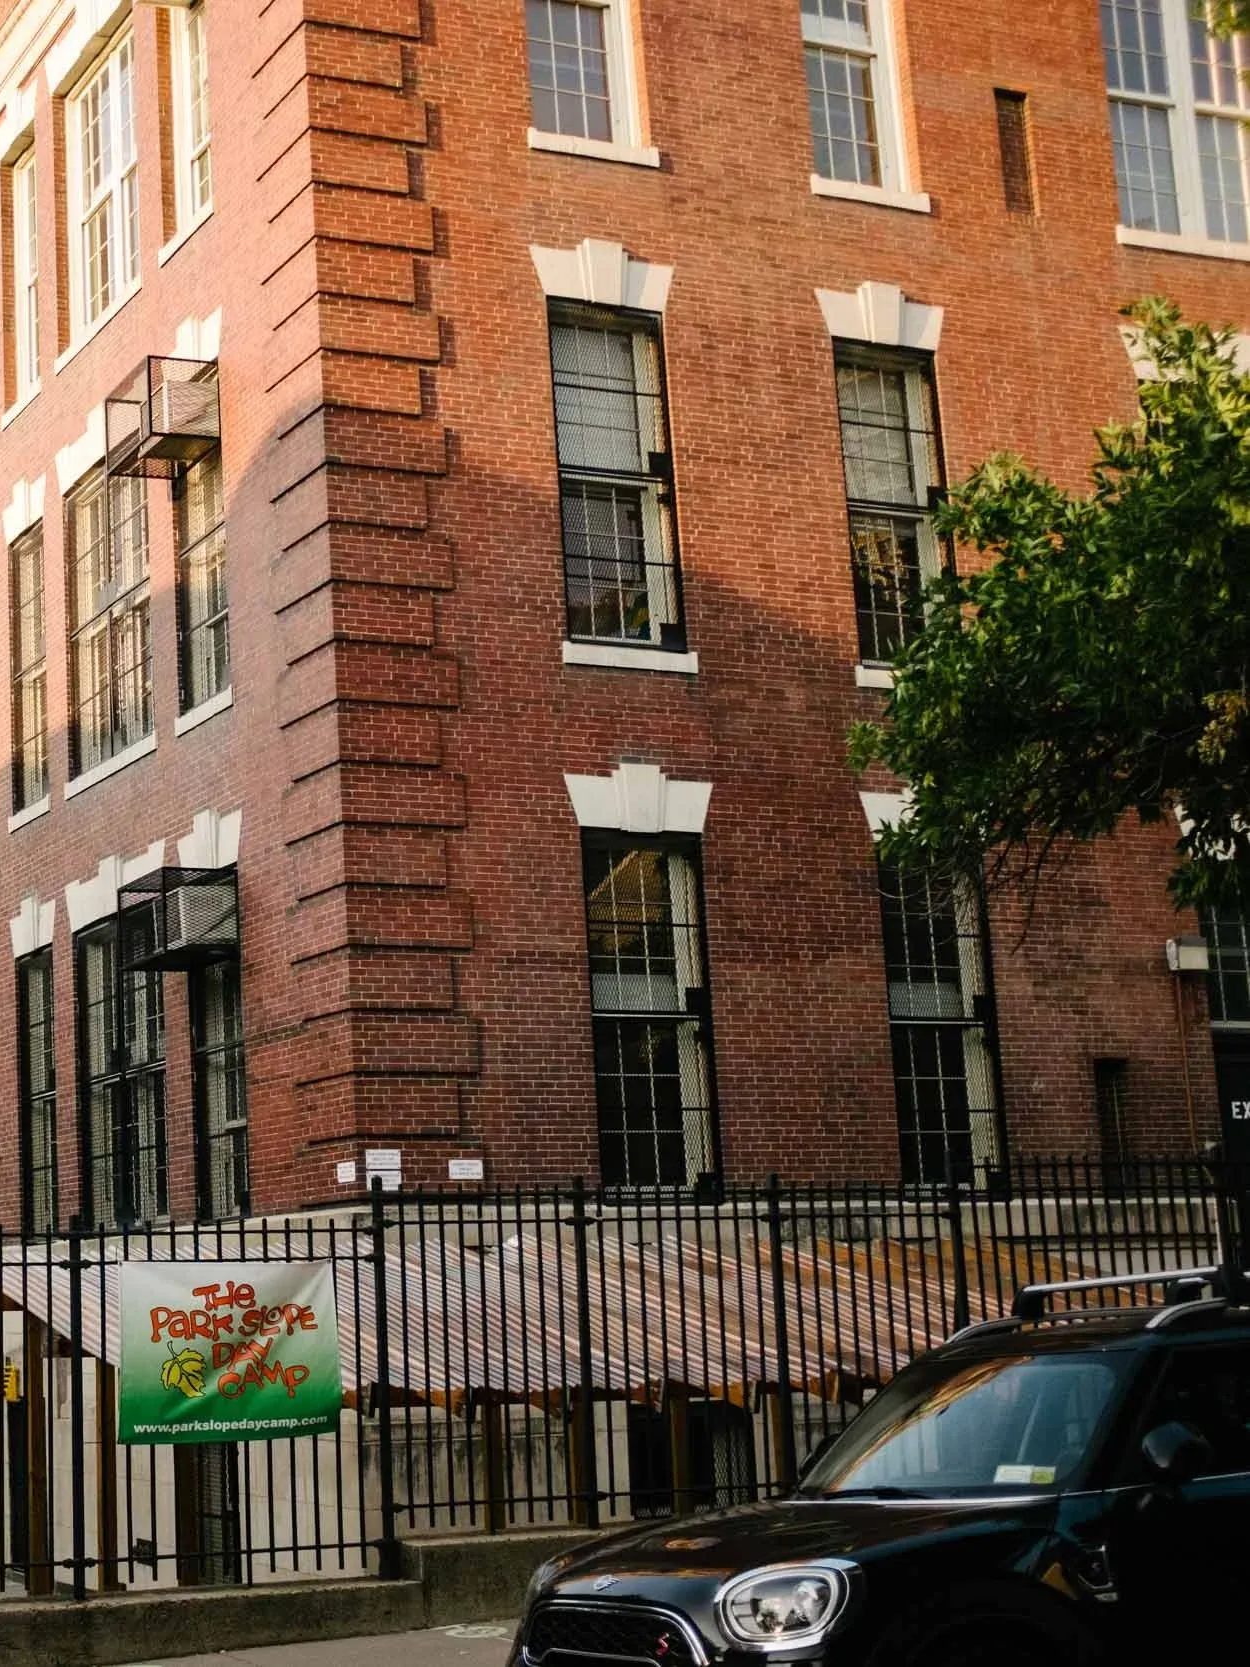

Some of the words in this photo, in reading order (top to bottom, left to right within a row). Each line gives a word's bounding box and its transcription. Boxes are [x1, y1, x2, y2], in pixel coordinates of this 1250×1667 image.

[237, 1302, 319, 1337] SLOPE
[211, 1337, 275, 1371] DAY
[217, 1359, 311, 1400] CAMP
[133, 1415, 328, 1435] www.parkslopedaycamp.com
